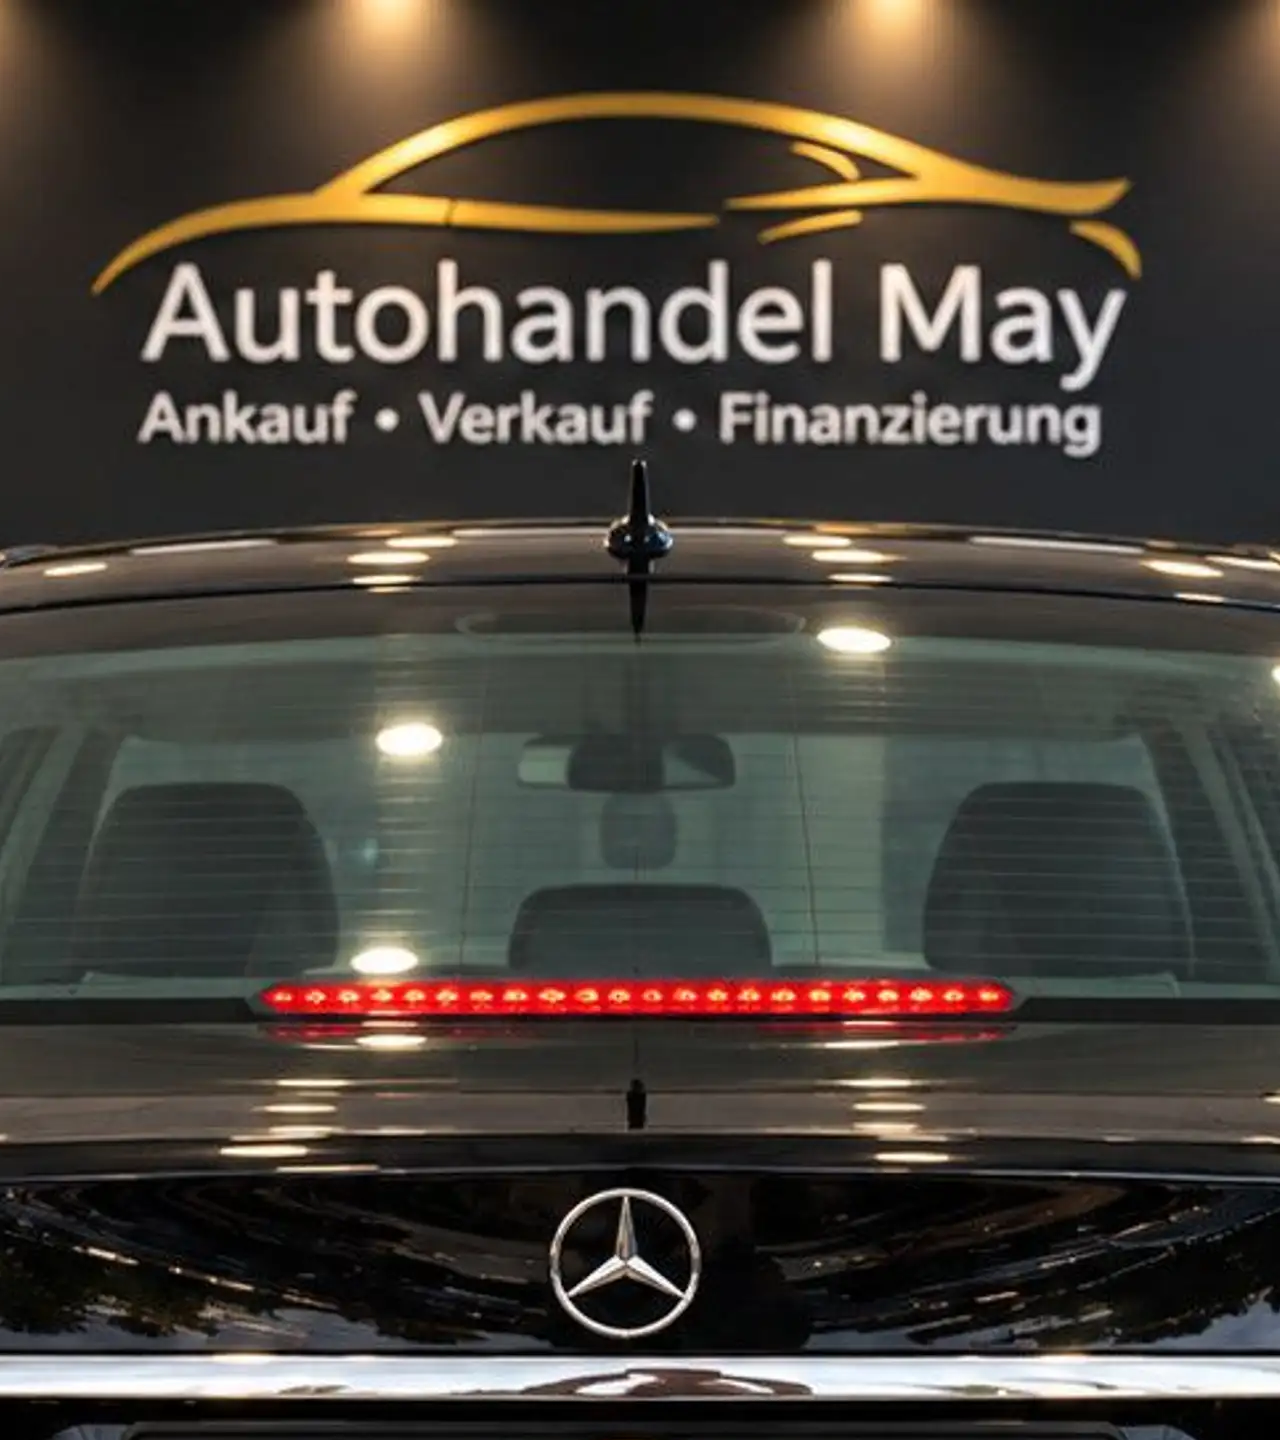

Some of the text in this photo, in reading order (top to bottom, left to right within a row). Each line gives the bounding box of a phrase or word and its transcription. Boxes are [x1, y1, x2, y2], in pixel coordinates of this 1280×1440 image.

[141, 259, 1126, 392] Autohandel May
[137, 388, 1102, 458] Ankauf Verkauf Finanzierung
